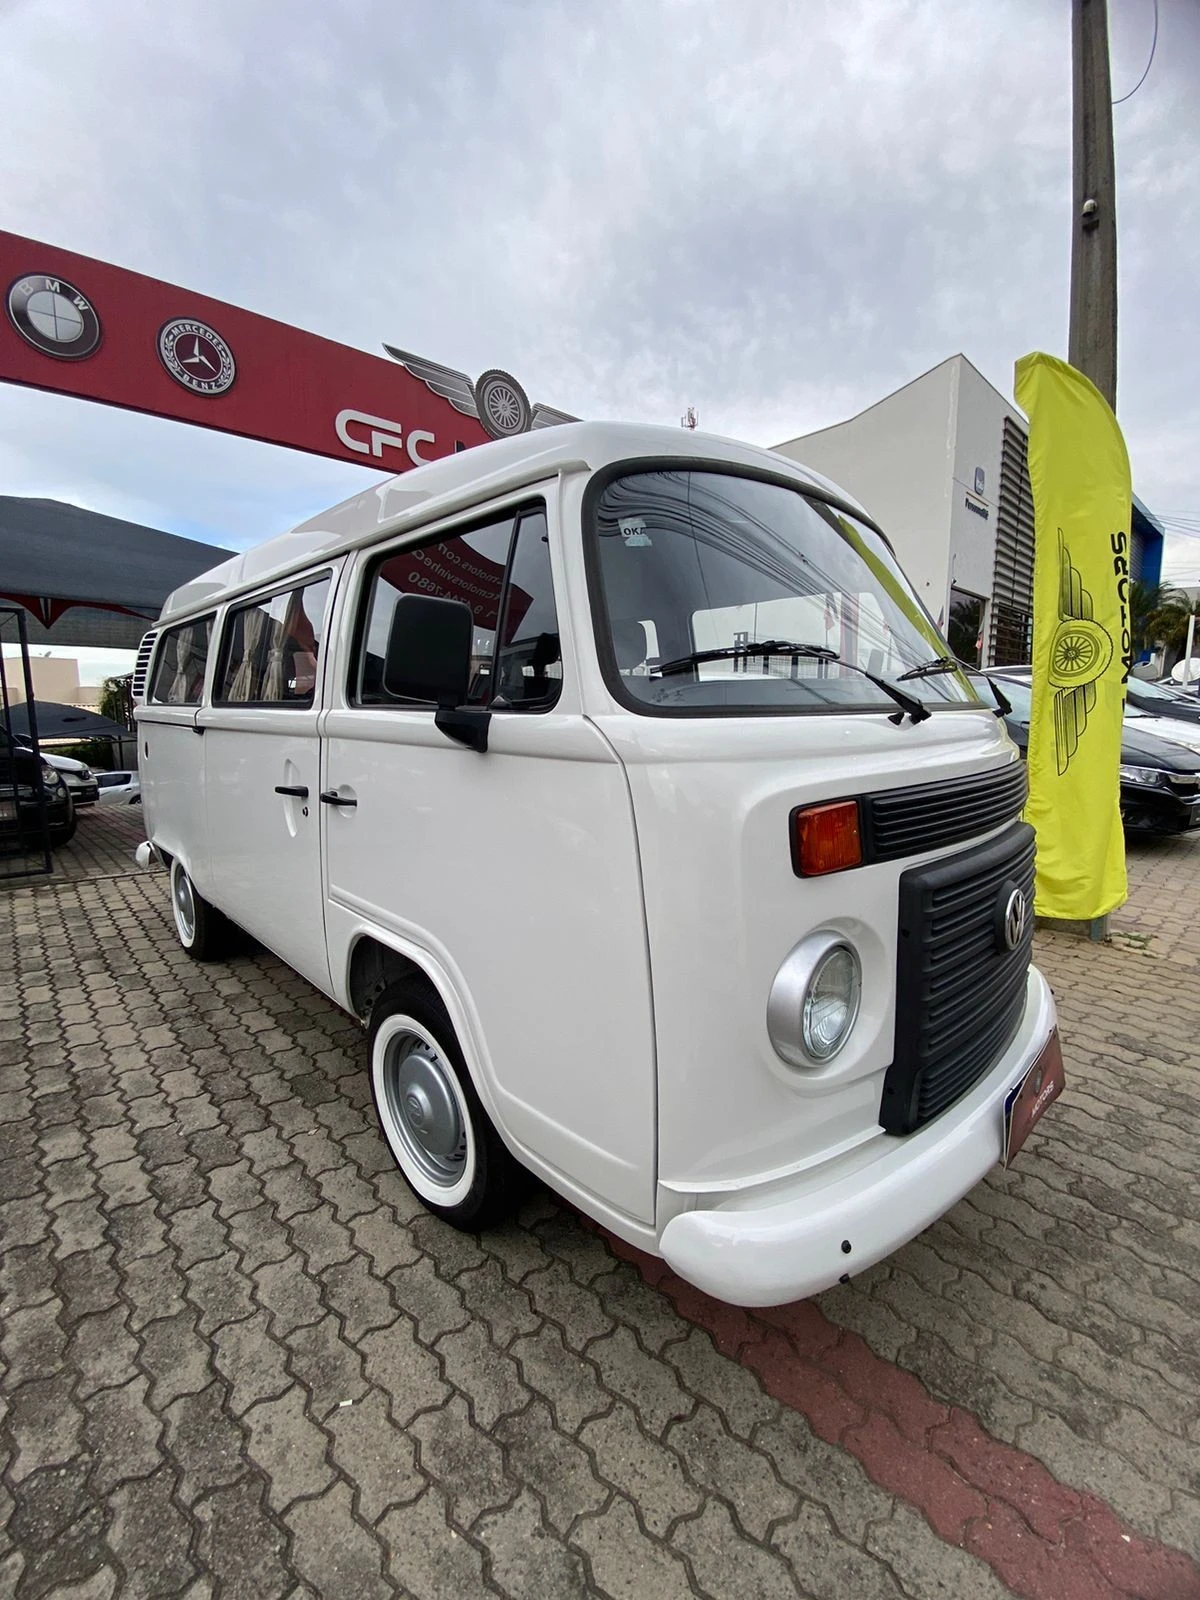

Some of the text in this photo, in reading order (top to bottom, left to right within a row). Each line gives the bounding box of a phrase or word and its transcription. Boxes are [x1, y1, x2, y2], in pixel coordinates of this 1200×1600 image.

[20, 279, 89, 312] BMW
[171, 324, 224, 352] MERCEDES
[183, 374, 218, 391] BENZ
[335, 408, 435, 468] CFC
